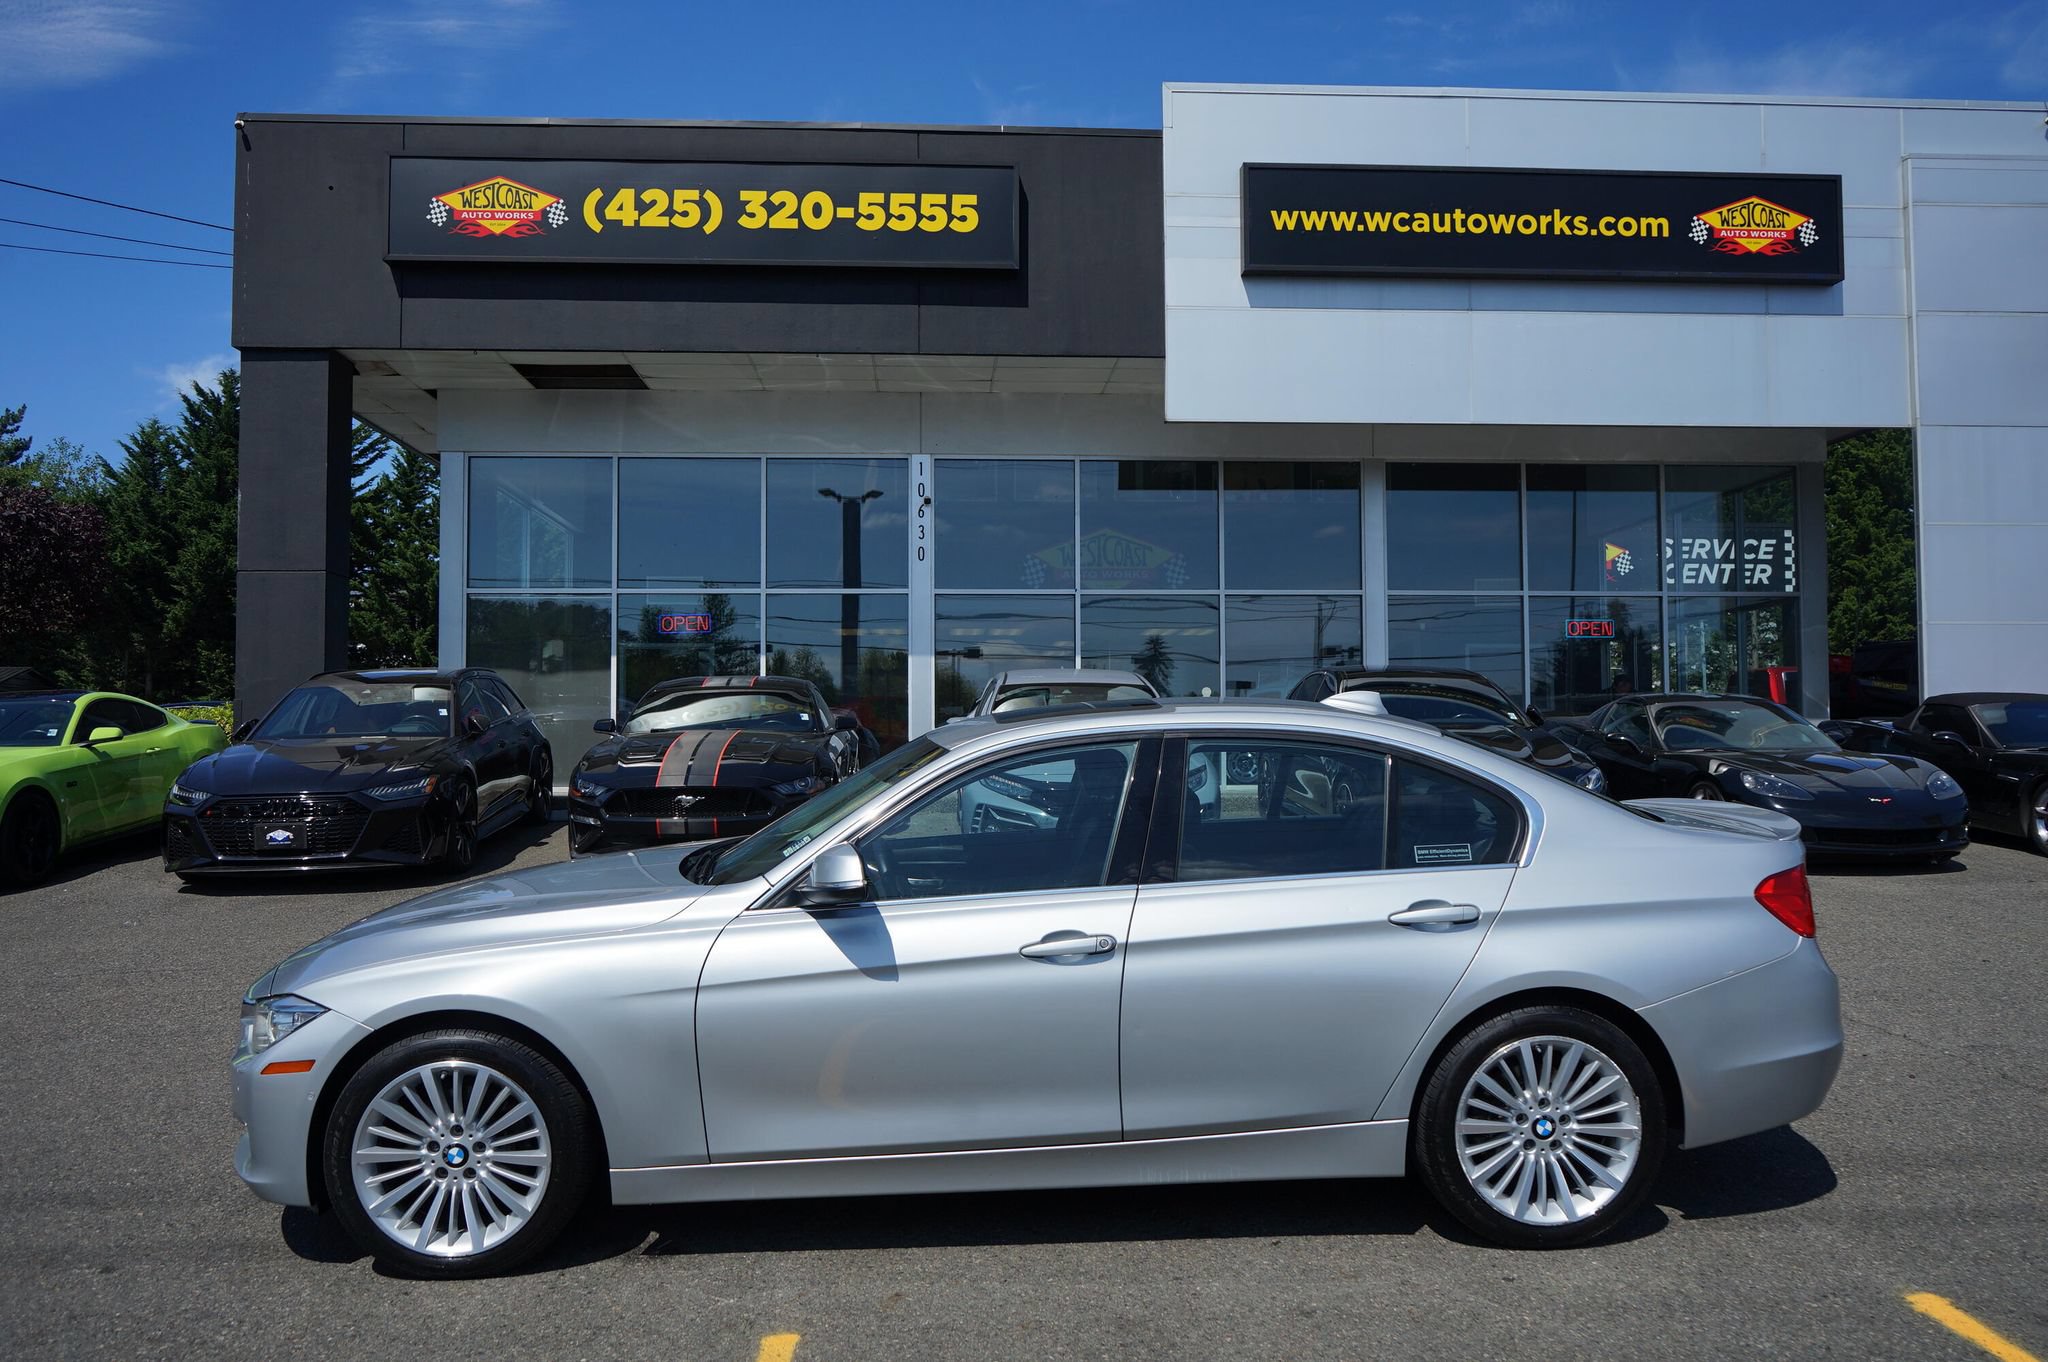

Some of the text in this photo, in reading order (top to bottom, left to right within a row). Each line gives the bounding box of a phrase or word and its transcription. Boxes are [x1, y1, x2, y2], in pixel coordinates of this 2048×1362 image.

[461, 211, 535, 220] AUTO WORKS
[582, 187, 979, 235] (425) 320-5555
[1270, 208, 1670, 238] www.wcautoworks.com
[1750, 230, 1787, 238] WORKS
[917, 461, 925, 562] 10630
[661, 616, 709, 632] OPEN
[1568, 621, 1612, 636] OPEN
